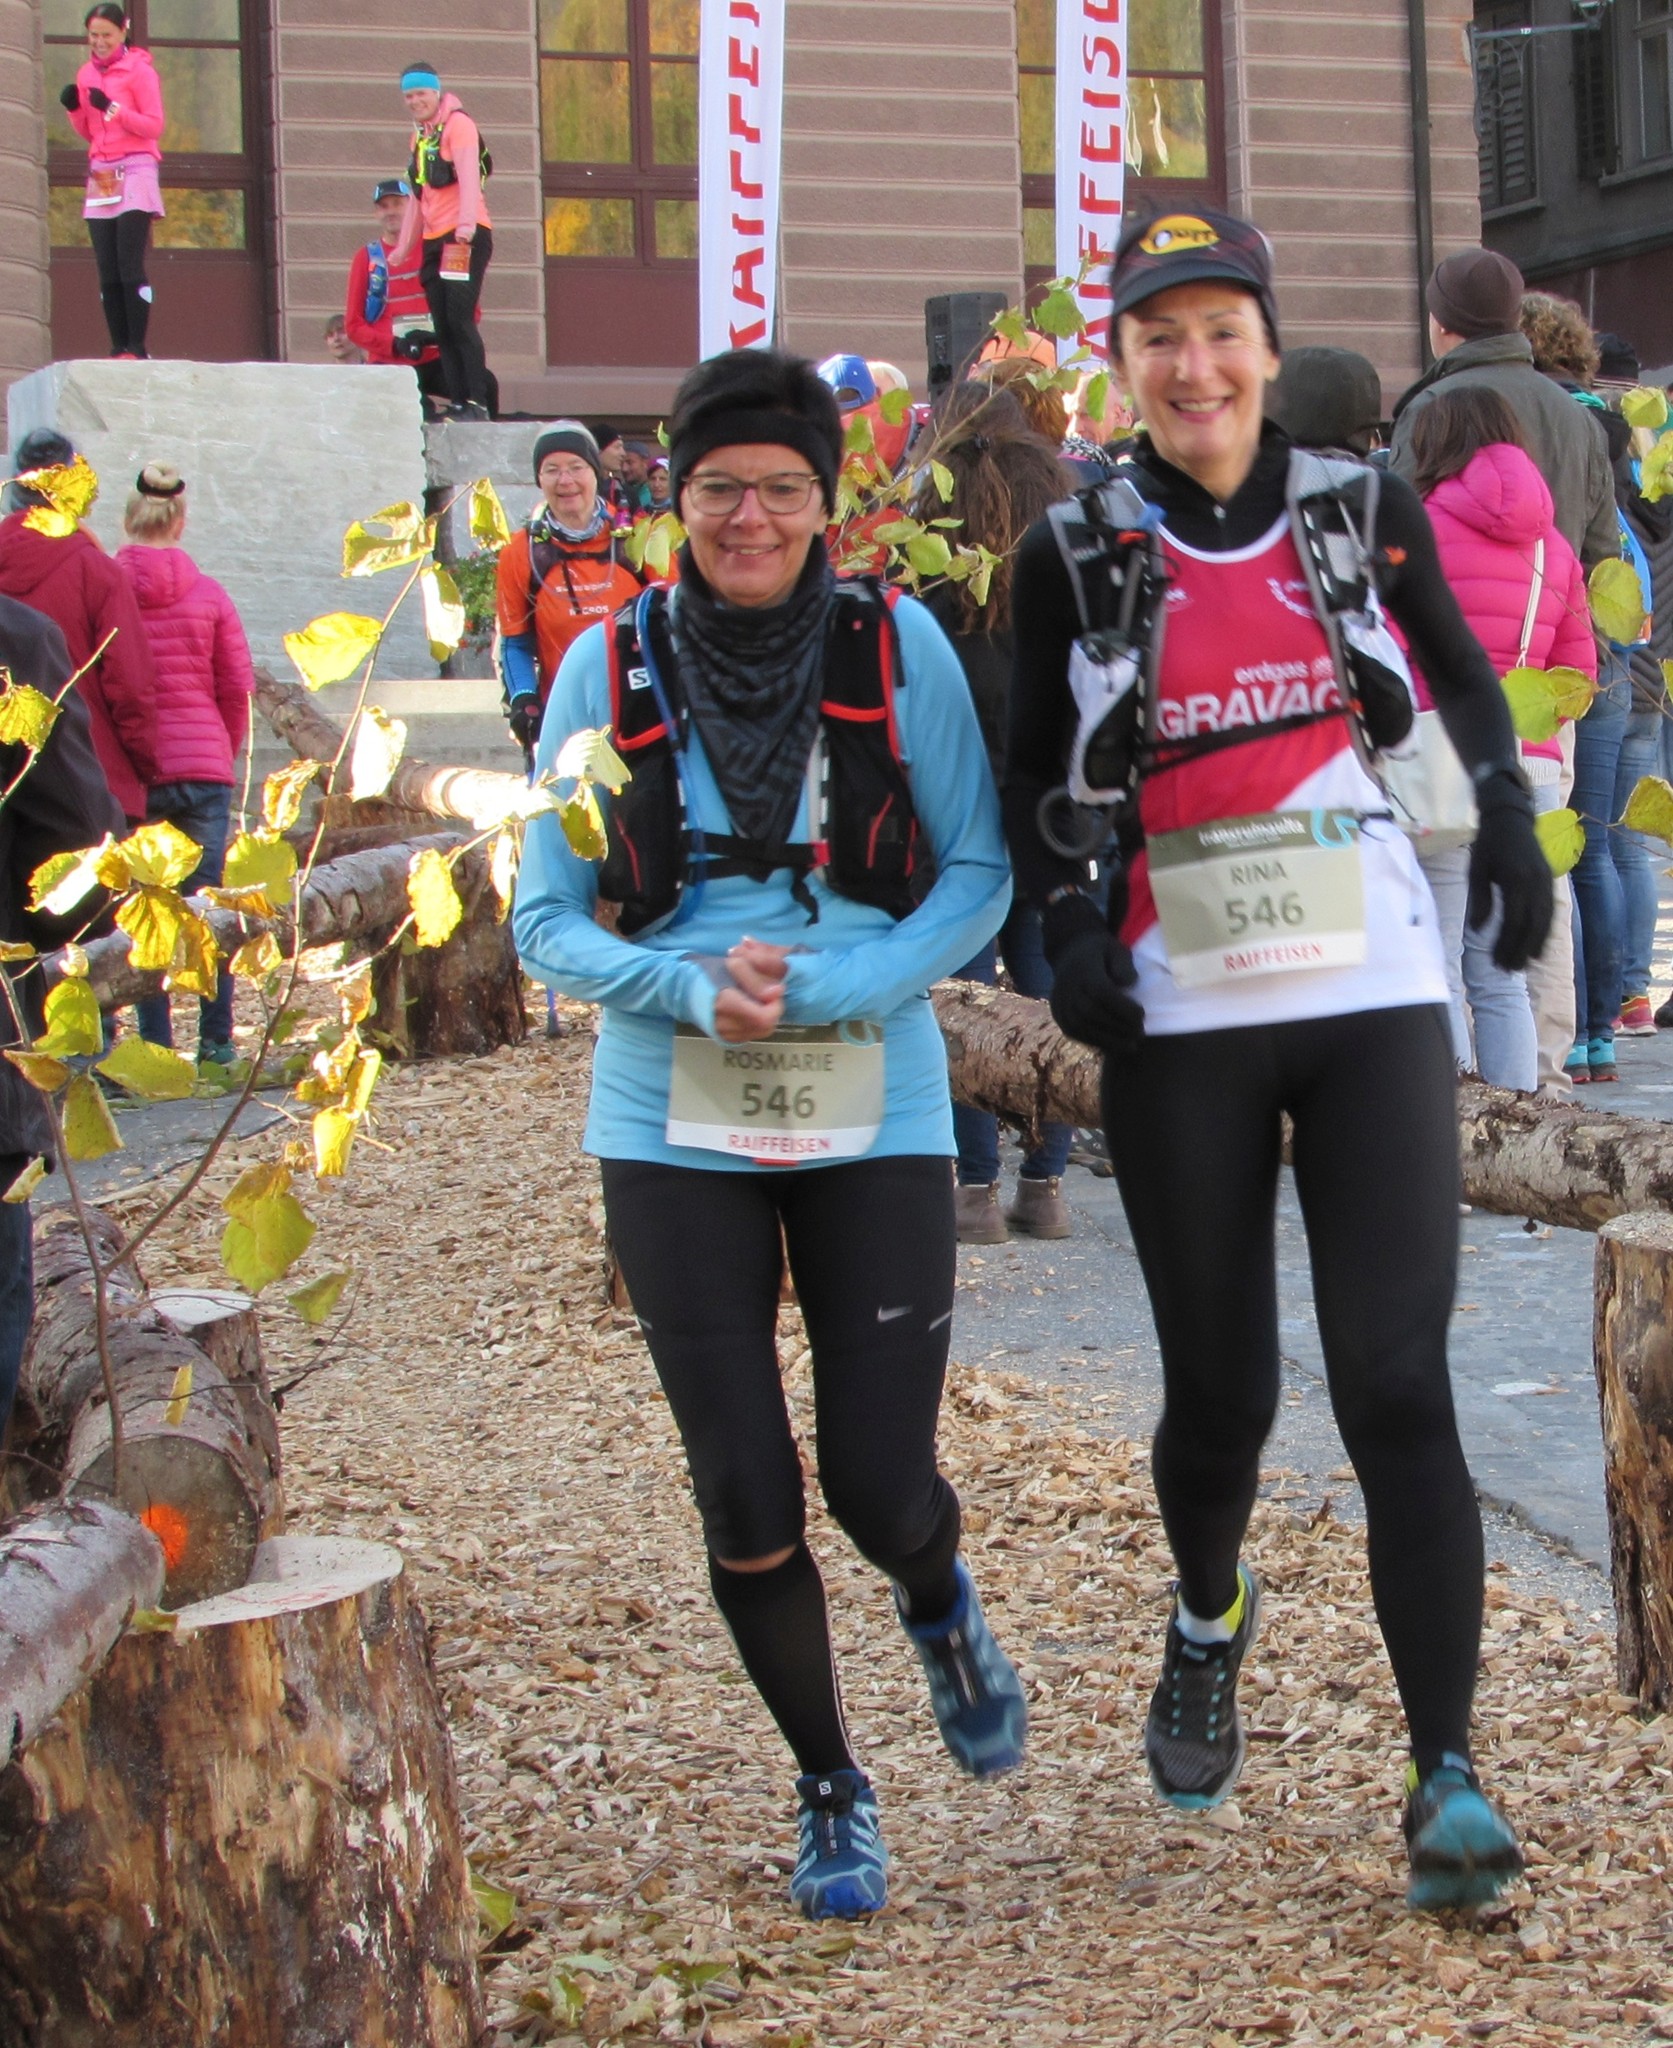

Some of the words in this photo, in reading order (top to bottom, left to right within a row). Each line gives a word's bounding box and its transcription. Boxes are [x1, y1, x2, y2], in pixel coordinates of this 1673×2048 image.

[1229, 861, 1289, 885] RINA
[1225, 891, 1305, 936] 546
[1223, 942, 1324, 972] RAIFFEISEN
[723, 1048, 835, 1073] ROSMARIE
[741, 1082, 816, 1119] 546
[727, 1133, 832, 1154] RAIFFEISEN
